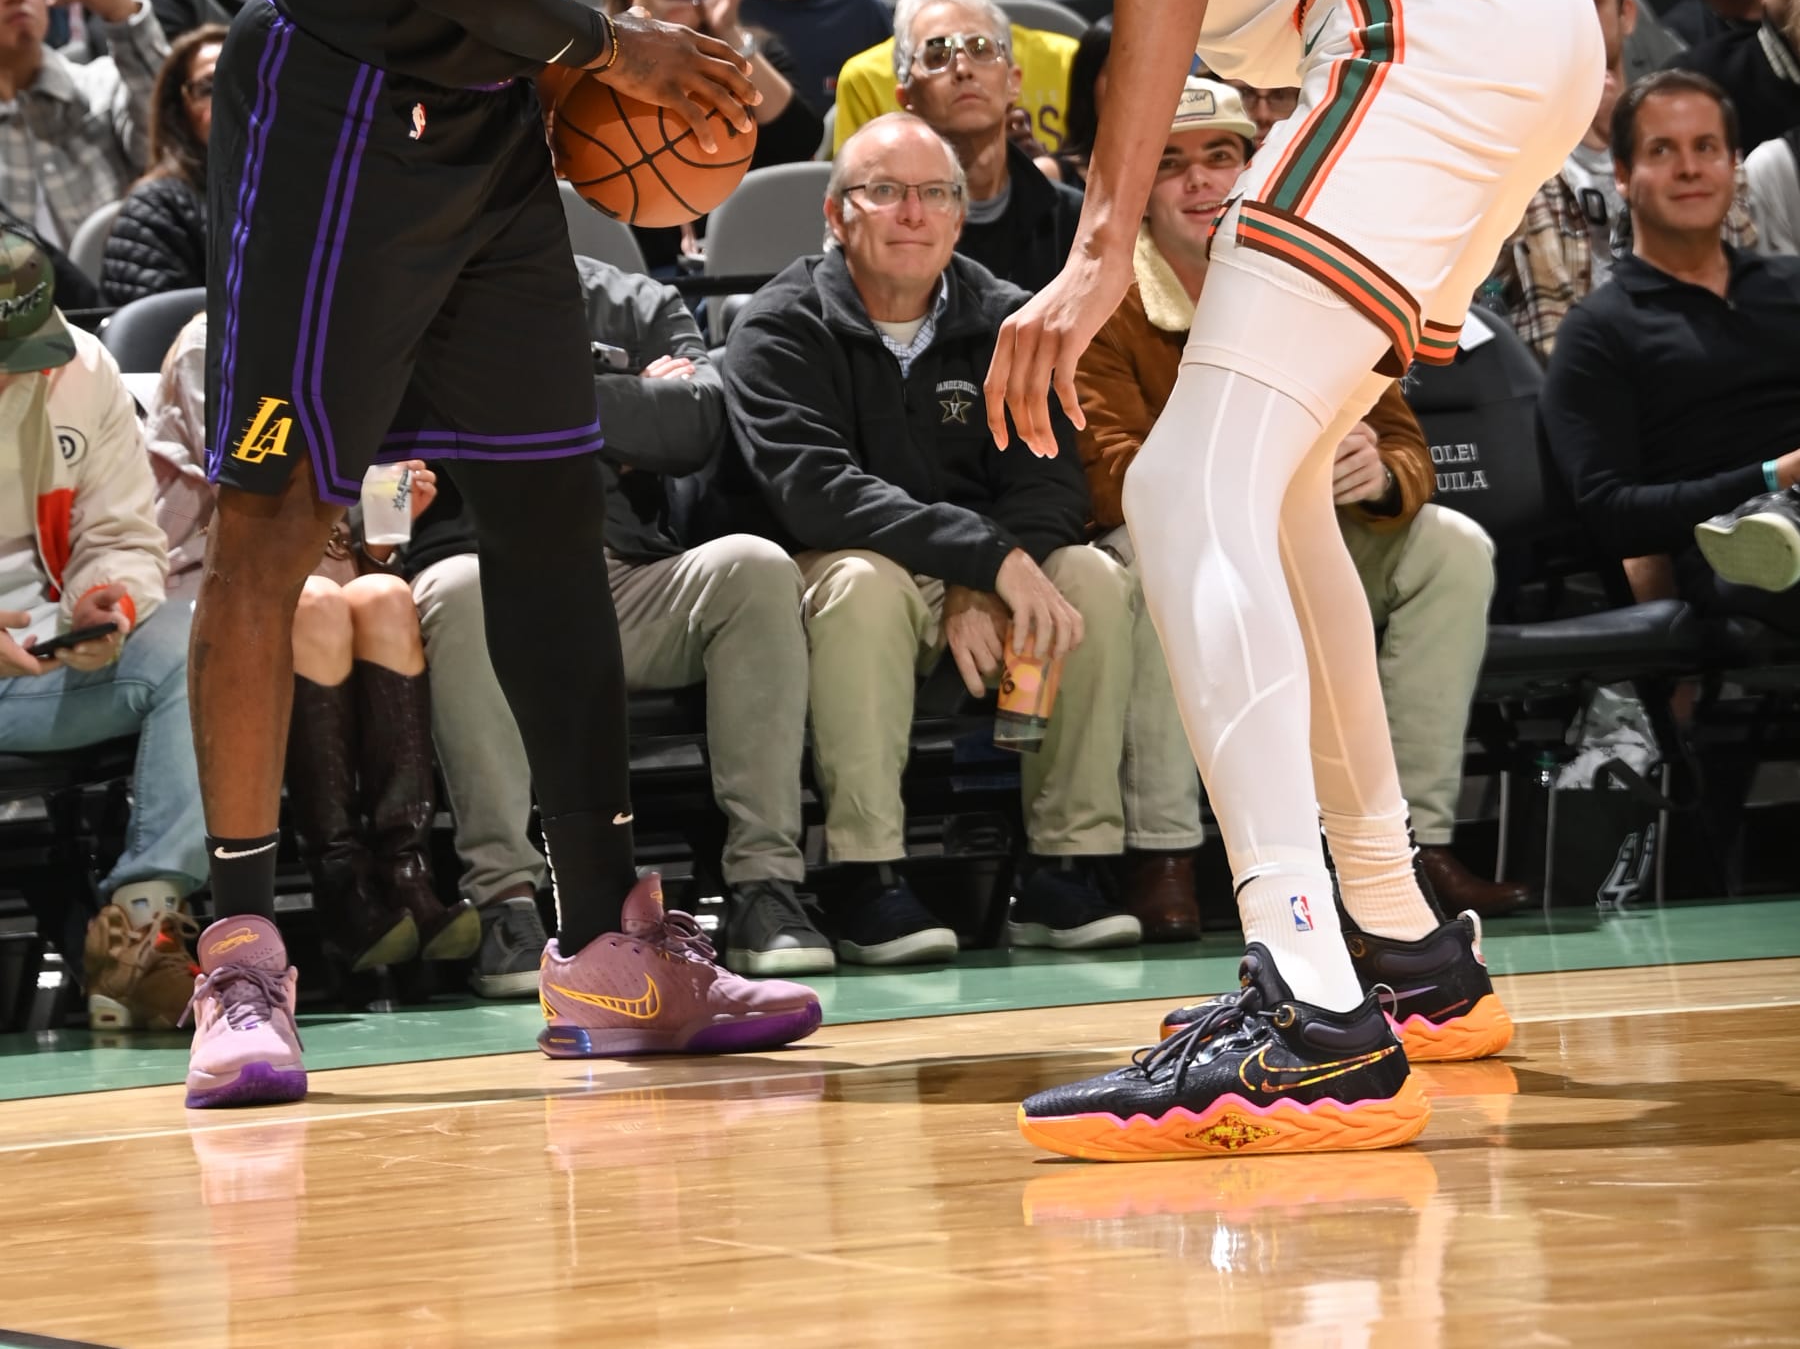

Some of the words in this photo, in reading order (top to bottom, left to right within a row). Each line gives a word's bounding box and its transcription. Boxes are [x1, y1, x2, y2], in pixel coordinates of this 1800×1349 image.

[231, 396, 293, 464] LA
[1430, 443, 1477, 463] OLE!
[1435, 470, 1488, 492] UILA
